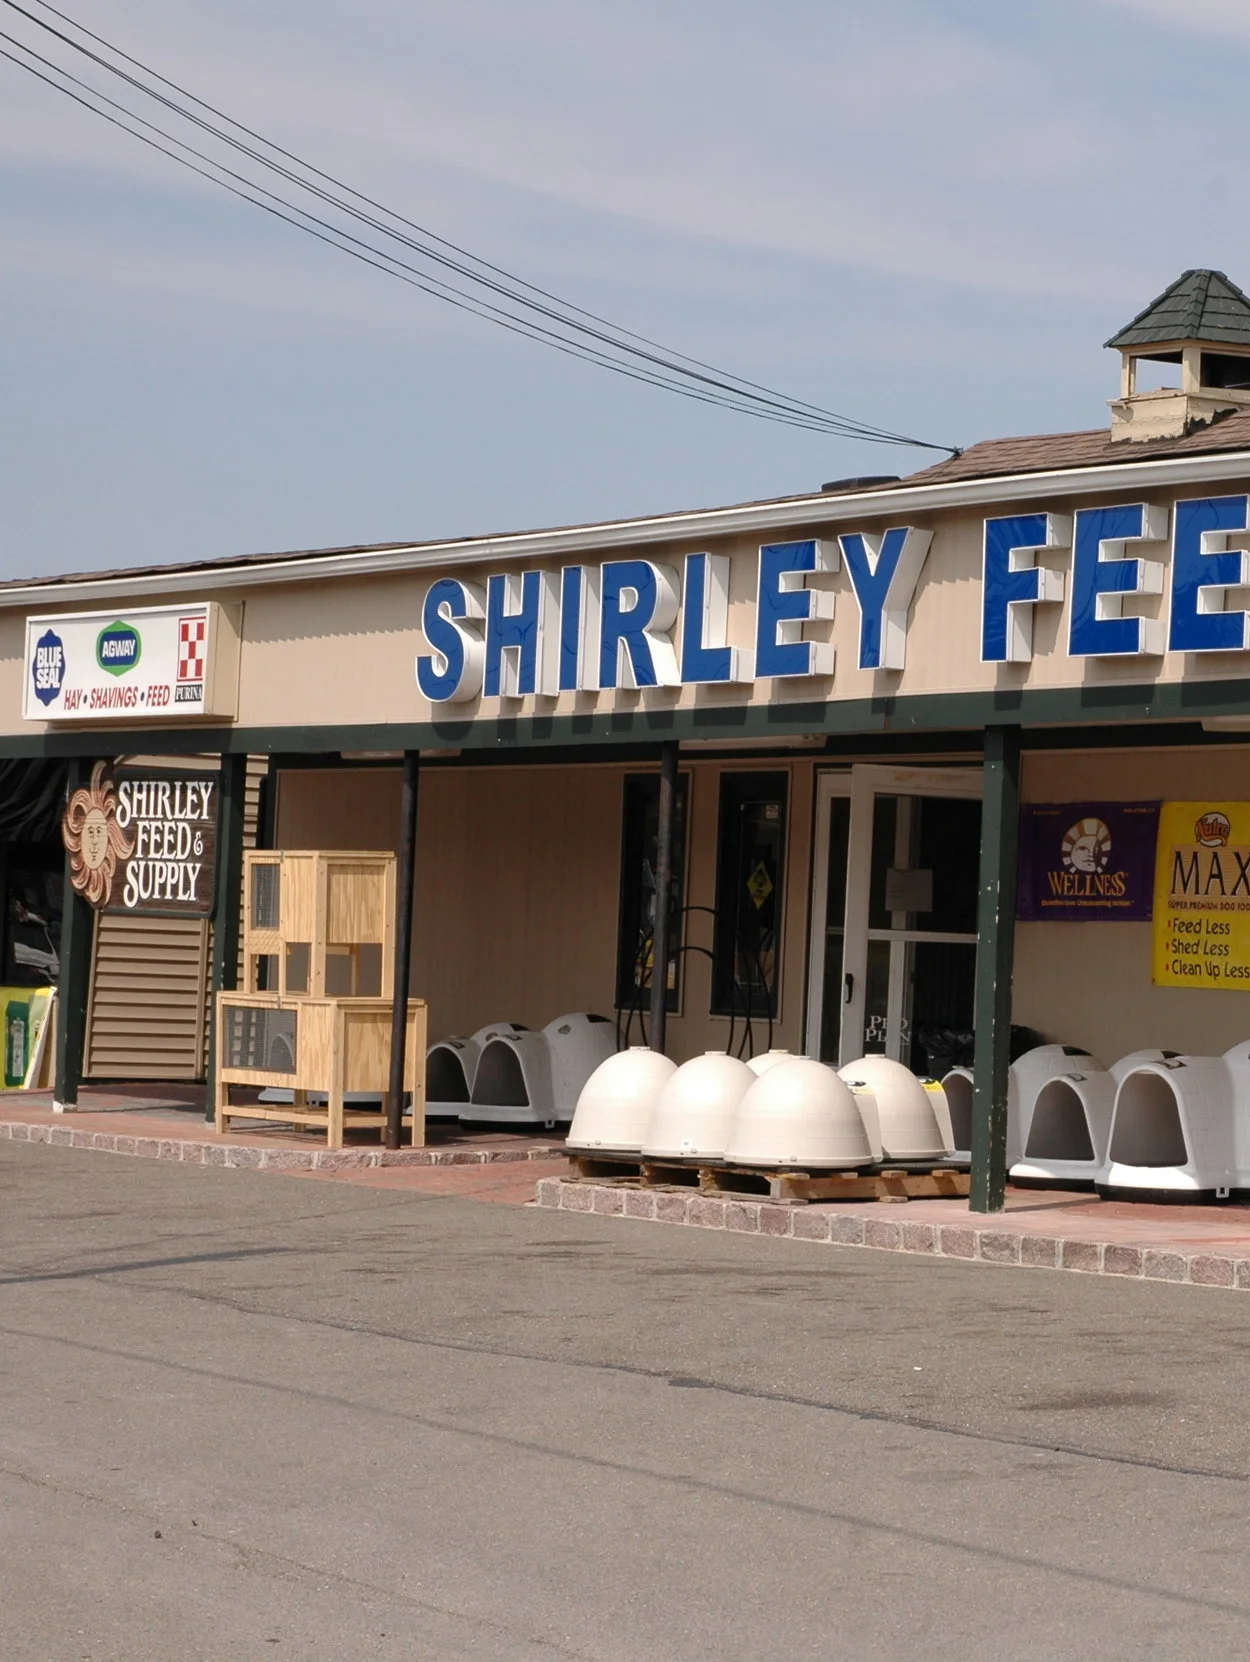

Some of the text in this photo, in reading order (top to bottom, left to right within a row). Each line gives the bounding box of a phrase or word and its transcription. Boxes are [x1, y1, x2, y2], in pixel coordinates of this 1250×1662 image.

[416, 527, 928, 702] SHIRLEY
[36, 647, 62, 668] BLUE
[102, 639, 135, 657] AGWAY
[36, 667, 60, 689] SEAL
[64, 685, 170, 710] HAY SHAVINGS FEED
[175, 686, 202, 701] PURINA
[115, 781, 214, 827] SHIRLEY
[135, 821, 203, 860] FEED &
[123, 861, 201, 907] SUPPLY
[1047, 871, 1125, 896] WELLNESS
[1173, 917, 1231, 935] Feed Less
[1171, 938, 1229, 956] Shed Less
[1171, 959, 1250, 980] Clean Up Less
[865, 1028, 910, 1042] PLN
